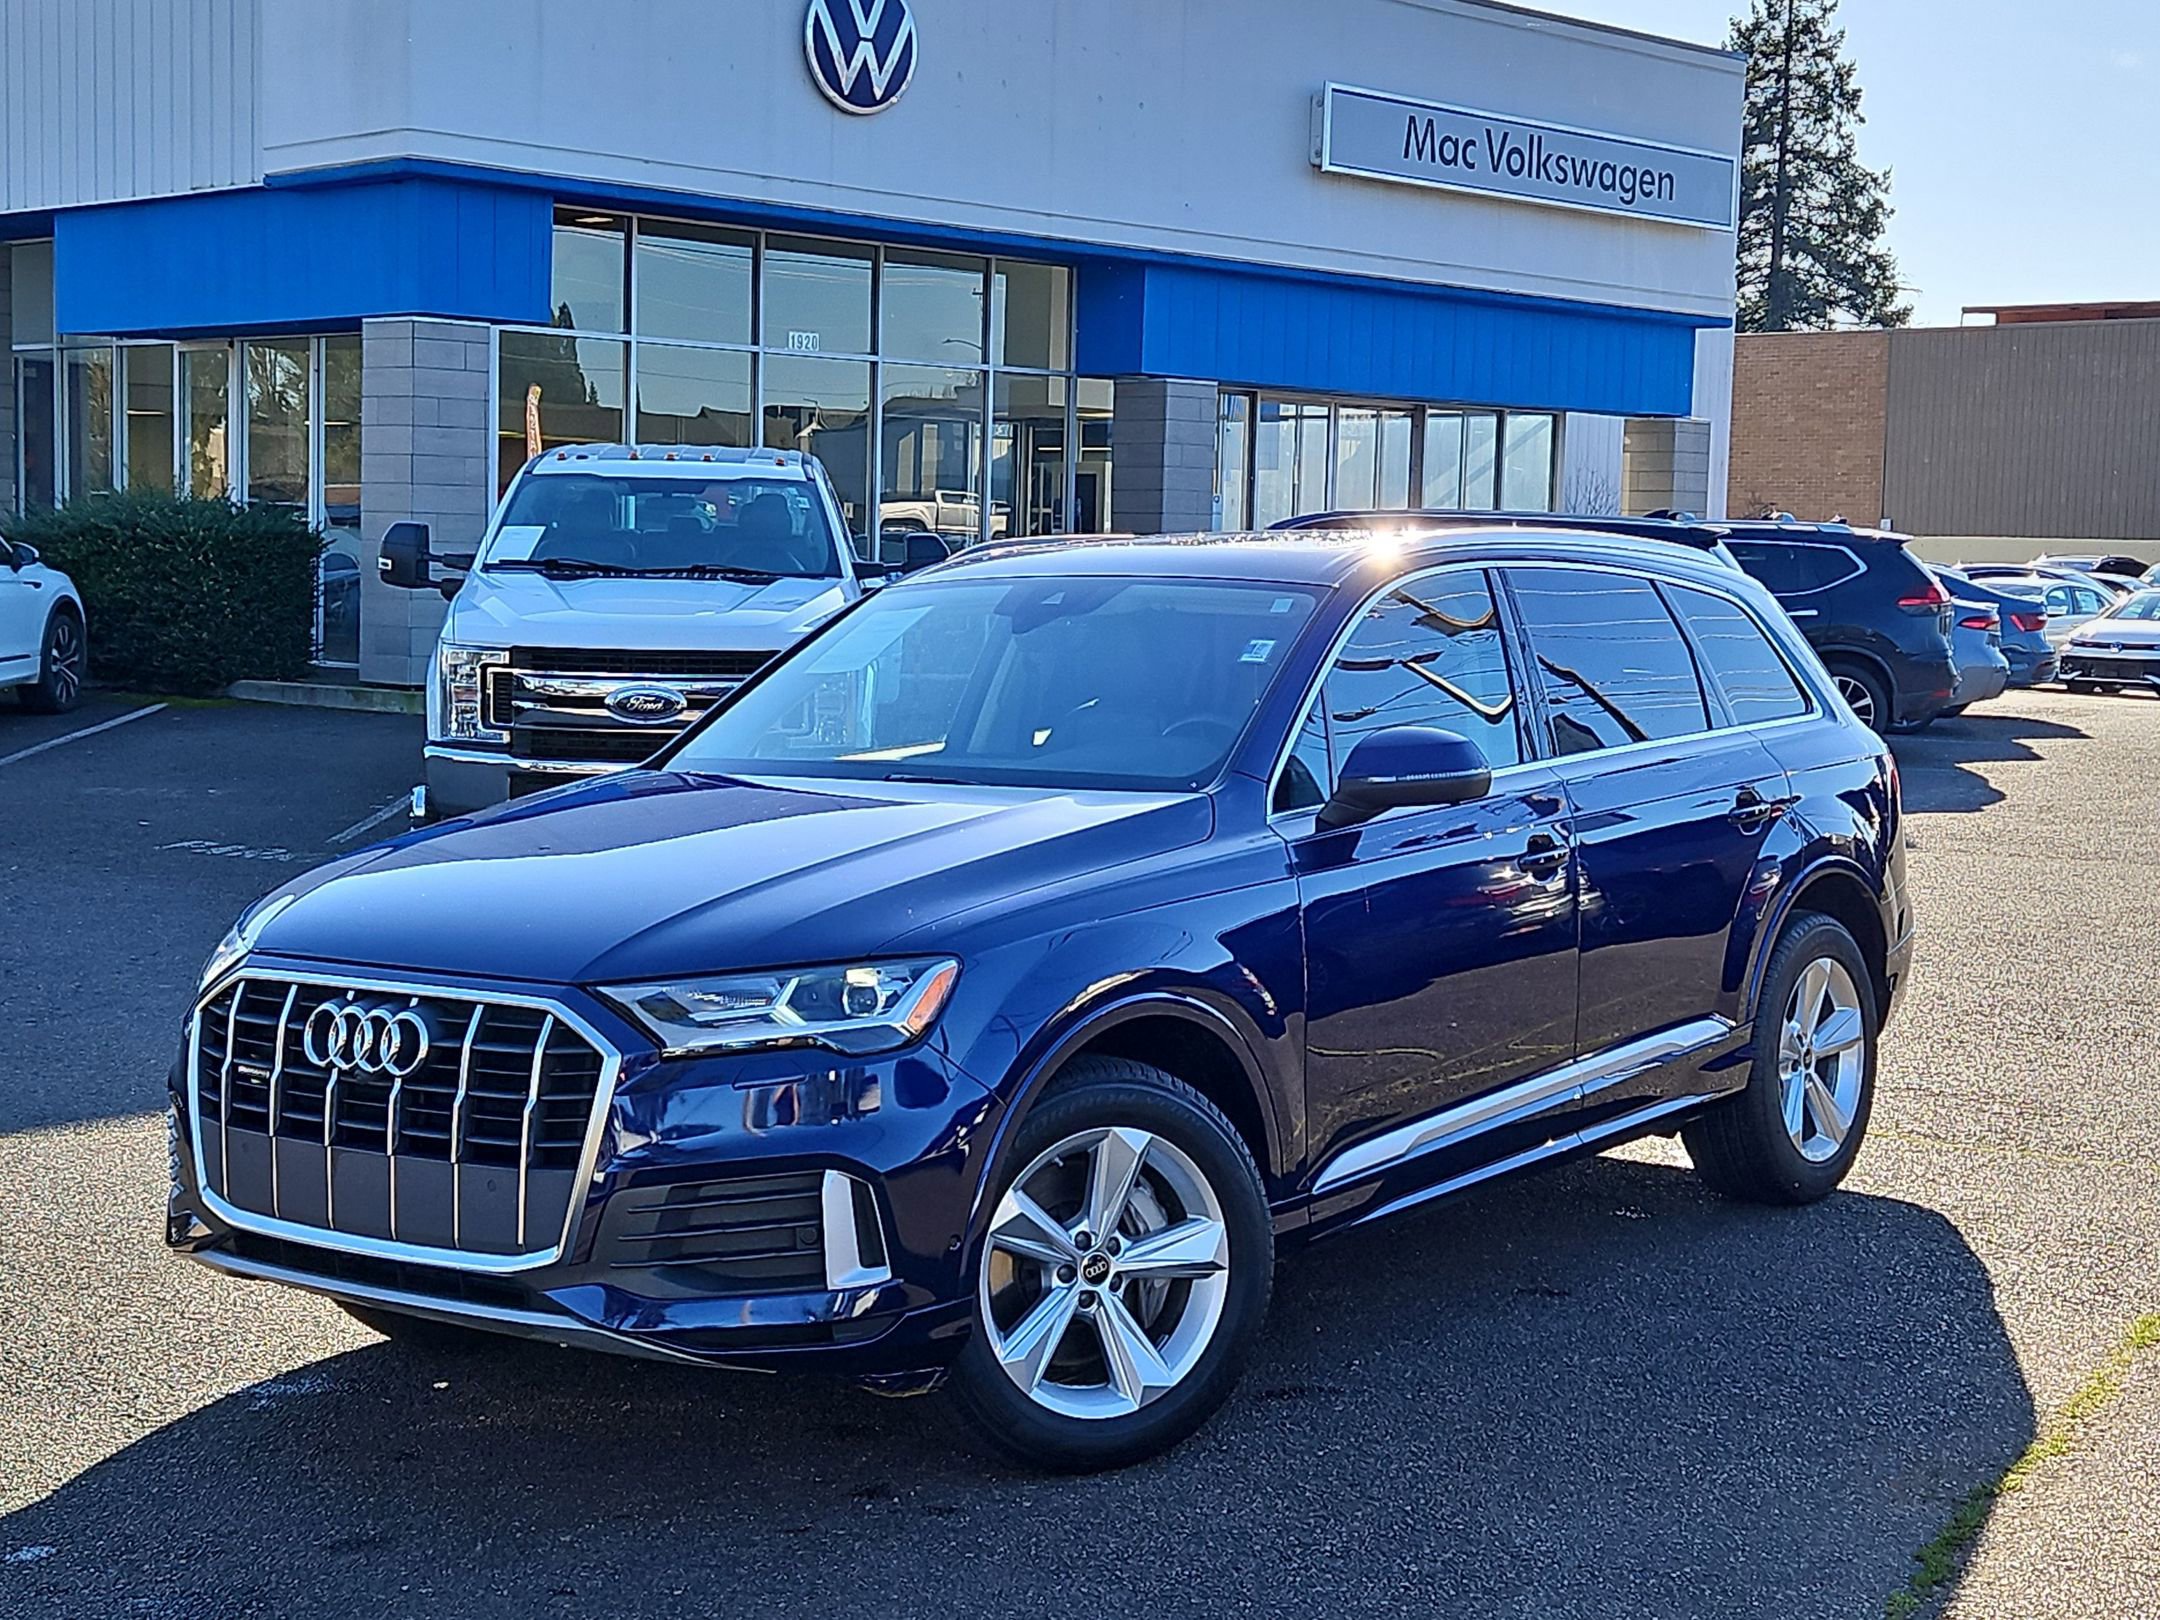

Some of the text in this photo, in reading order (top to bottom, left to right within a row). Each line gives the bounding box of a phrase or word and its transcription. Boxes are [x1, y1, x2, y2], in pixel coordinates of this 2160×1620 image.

[1402, 114, 1674, 206] Mac Volkswagen
[790, 333, 818, 350] 1920
[626, 695, 665, 711] Ford
